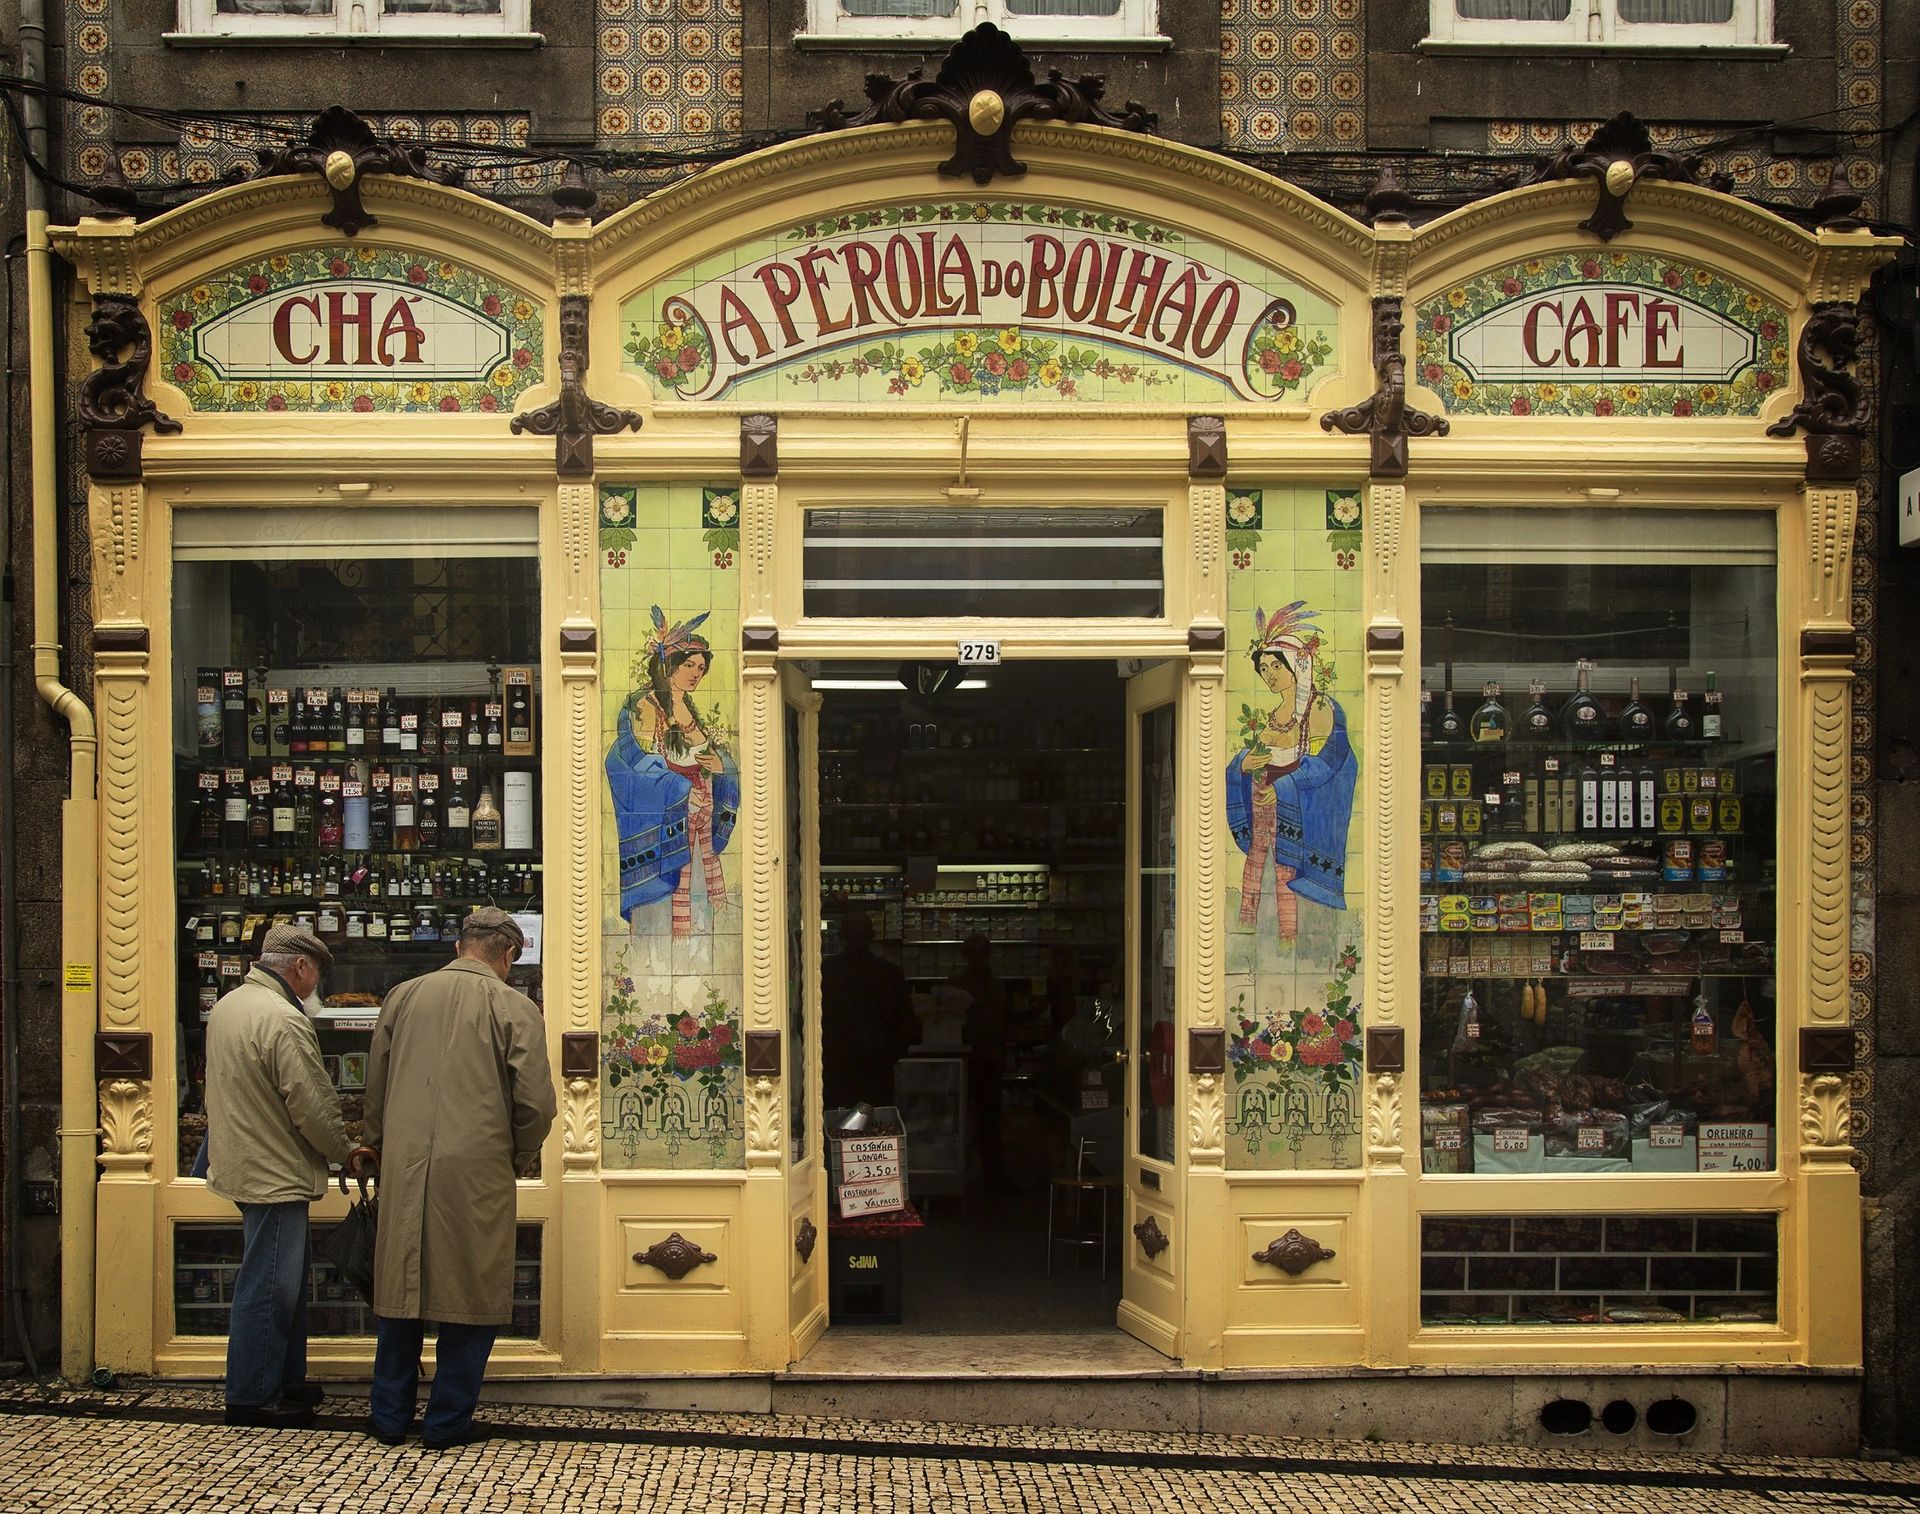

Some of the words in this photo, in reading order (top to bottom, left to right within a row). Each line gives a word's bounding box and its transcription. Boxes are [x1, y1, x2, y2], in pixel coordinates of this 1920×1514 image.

[752, 233, 982, 348] PÉROLA
[981, 260, 1025, 299] DO
[1021, 234, 1240, 359] BOLHÃO
[273, 292, 424, 367] CHÁ
[1523, 293, 1683, 368] CAFÉ
[964, 645, 995, 660] 279
[1442, 1141, 1458, 1149] 8.00
[1503, 1141, 1524, 1149] 8.00
[1659, 1136, 1676, 1144] 6.00
[851, 1141, 893, 1152] CASTANHA
[857, 1153, 888, 1162] LONGAL
[1733, 1155, 1761, 1170] 4.00
[844, 1188, 878, 1198] CASTANHA
